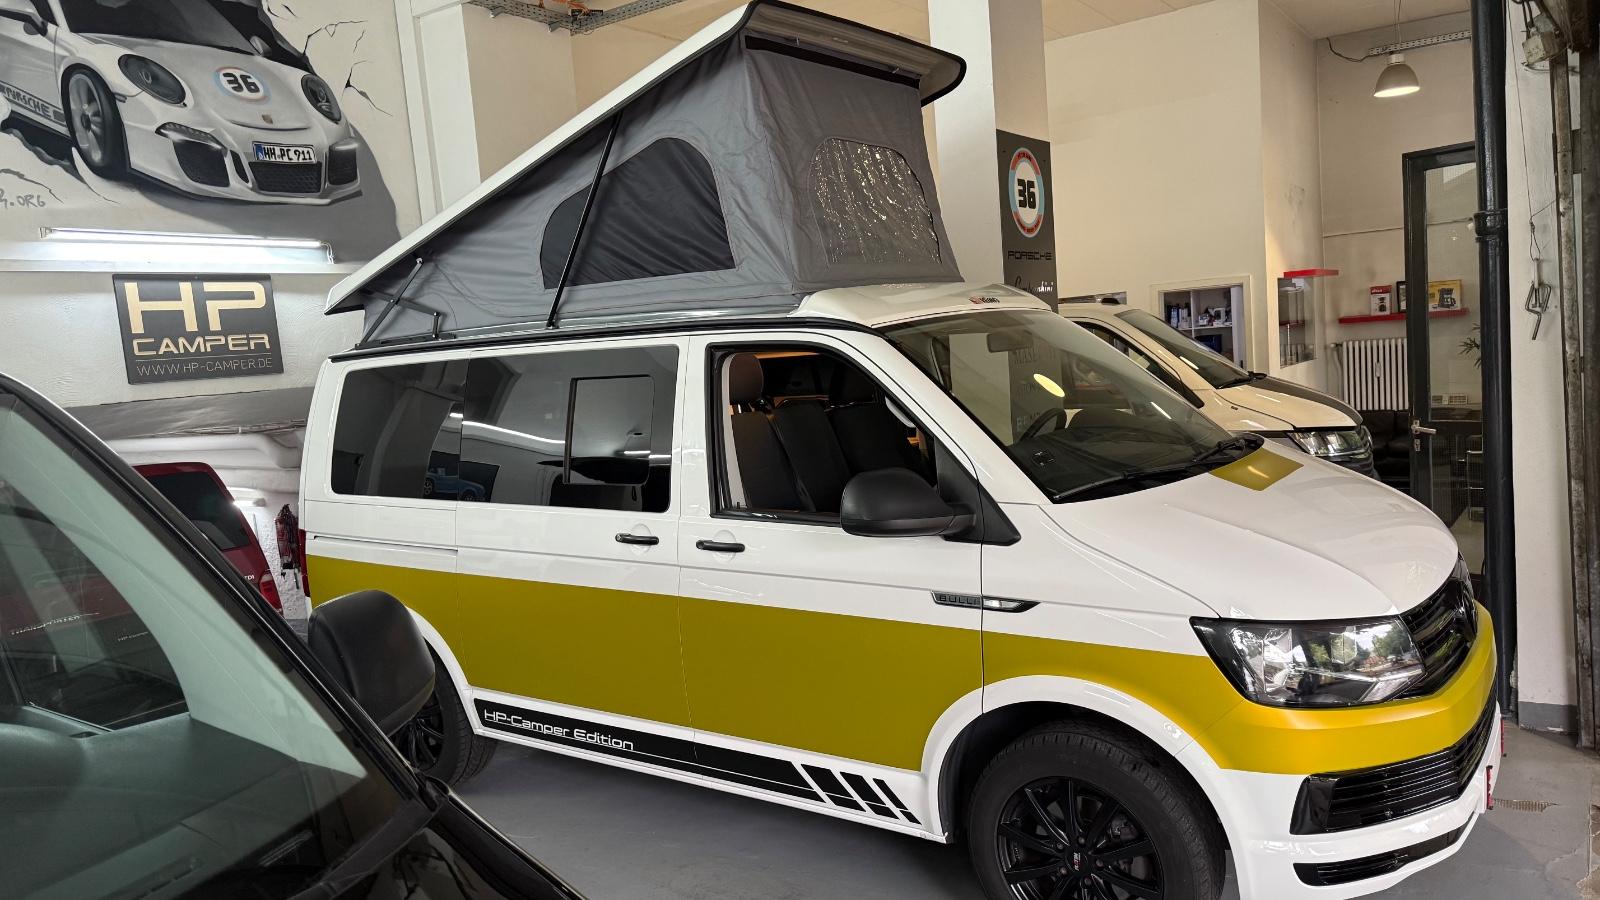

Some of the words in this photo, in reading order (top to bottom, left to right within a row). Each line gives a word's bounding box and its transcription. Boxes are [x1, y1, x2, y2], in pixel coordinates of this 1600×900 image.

[222, 72, 260, 94] 36
[1017, 178, 1037, 210] 36
[1007, 250, 1053, 261] PORSCHE
[124, 281, 267, 334] HP
[132, 333, 271, 356] CAMPER
[136, 357, 273, 377] WWW.HP-CAMPER.DE
[484, 709, 569, 735] HP-Camper
[573, 728, 634, 751] Edition
